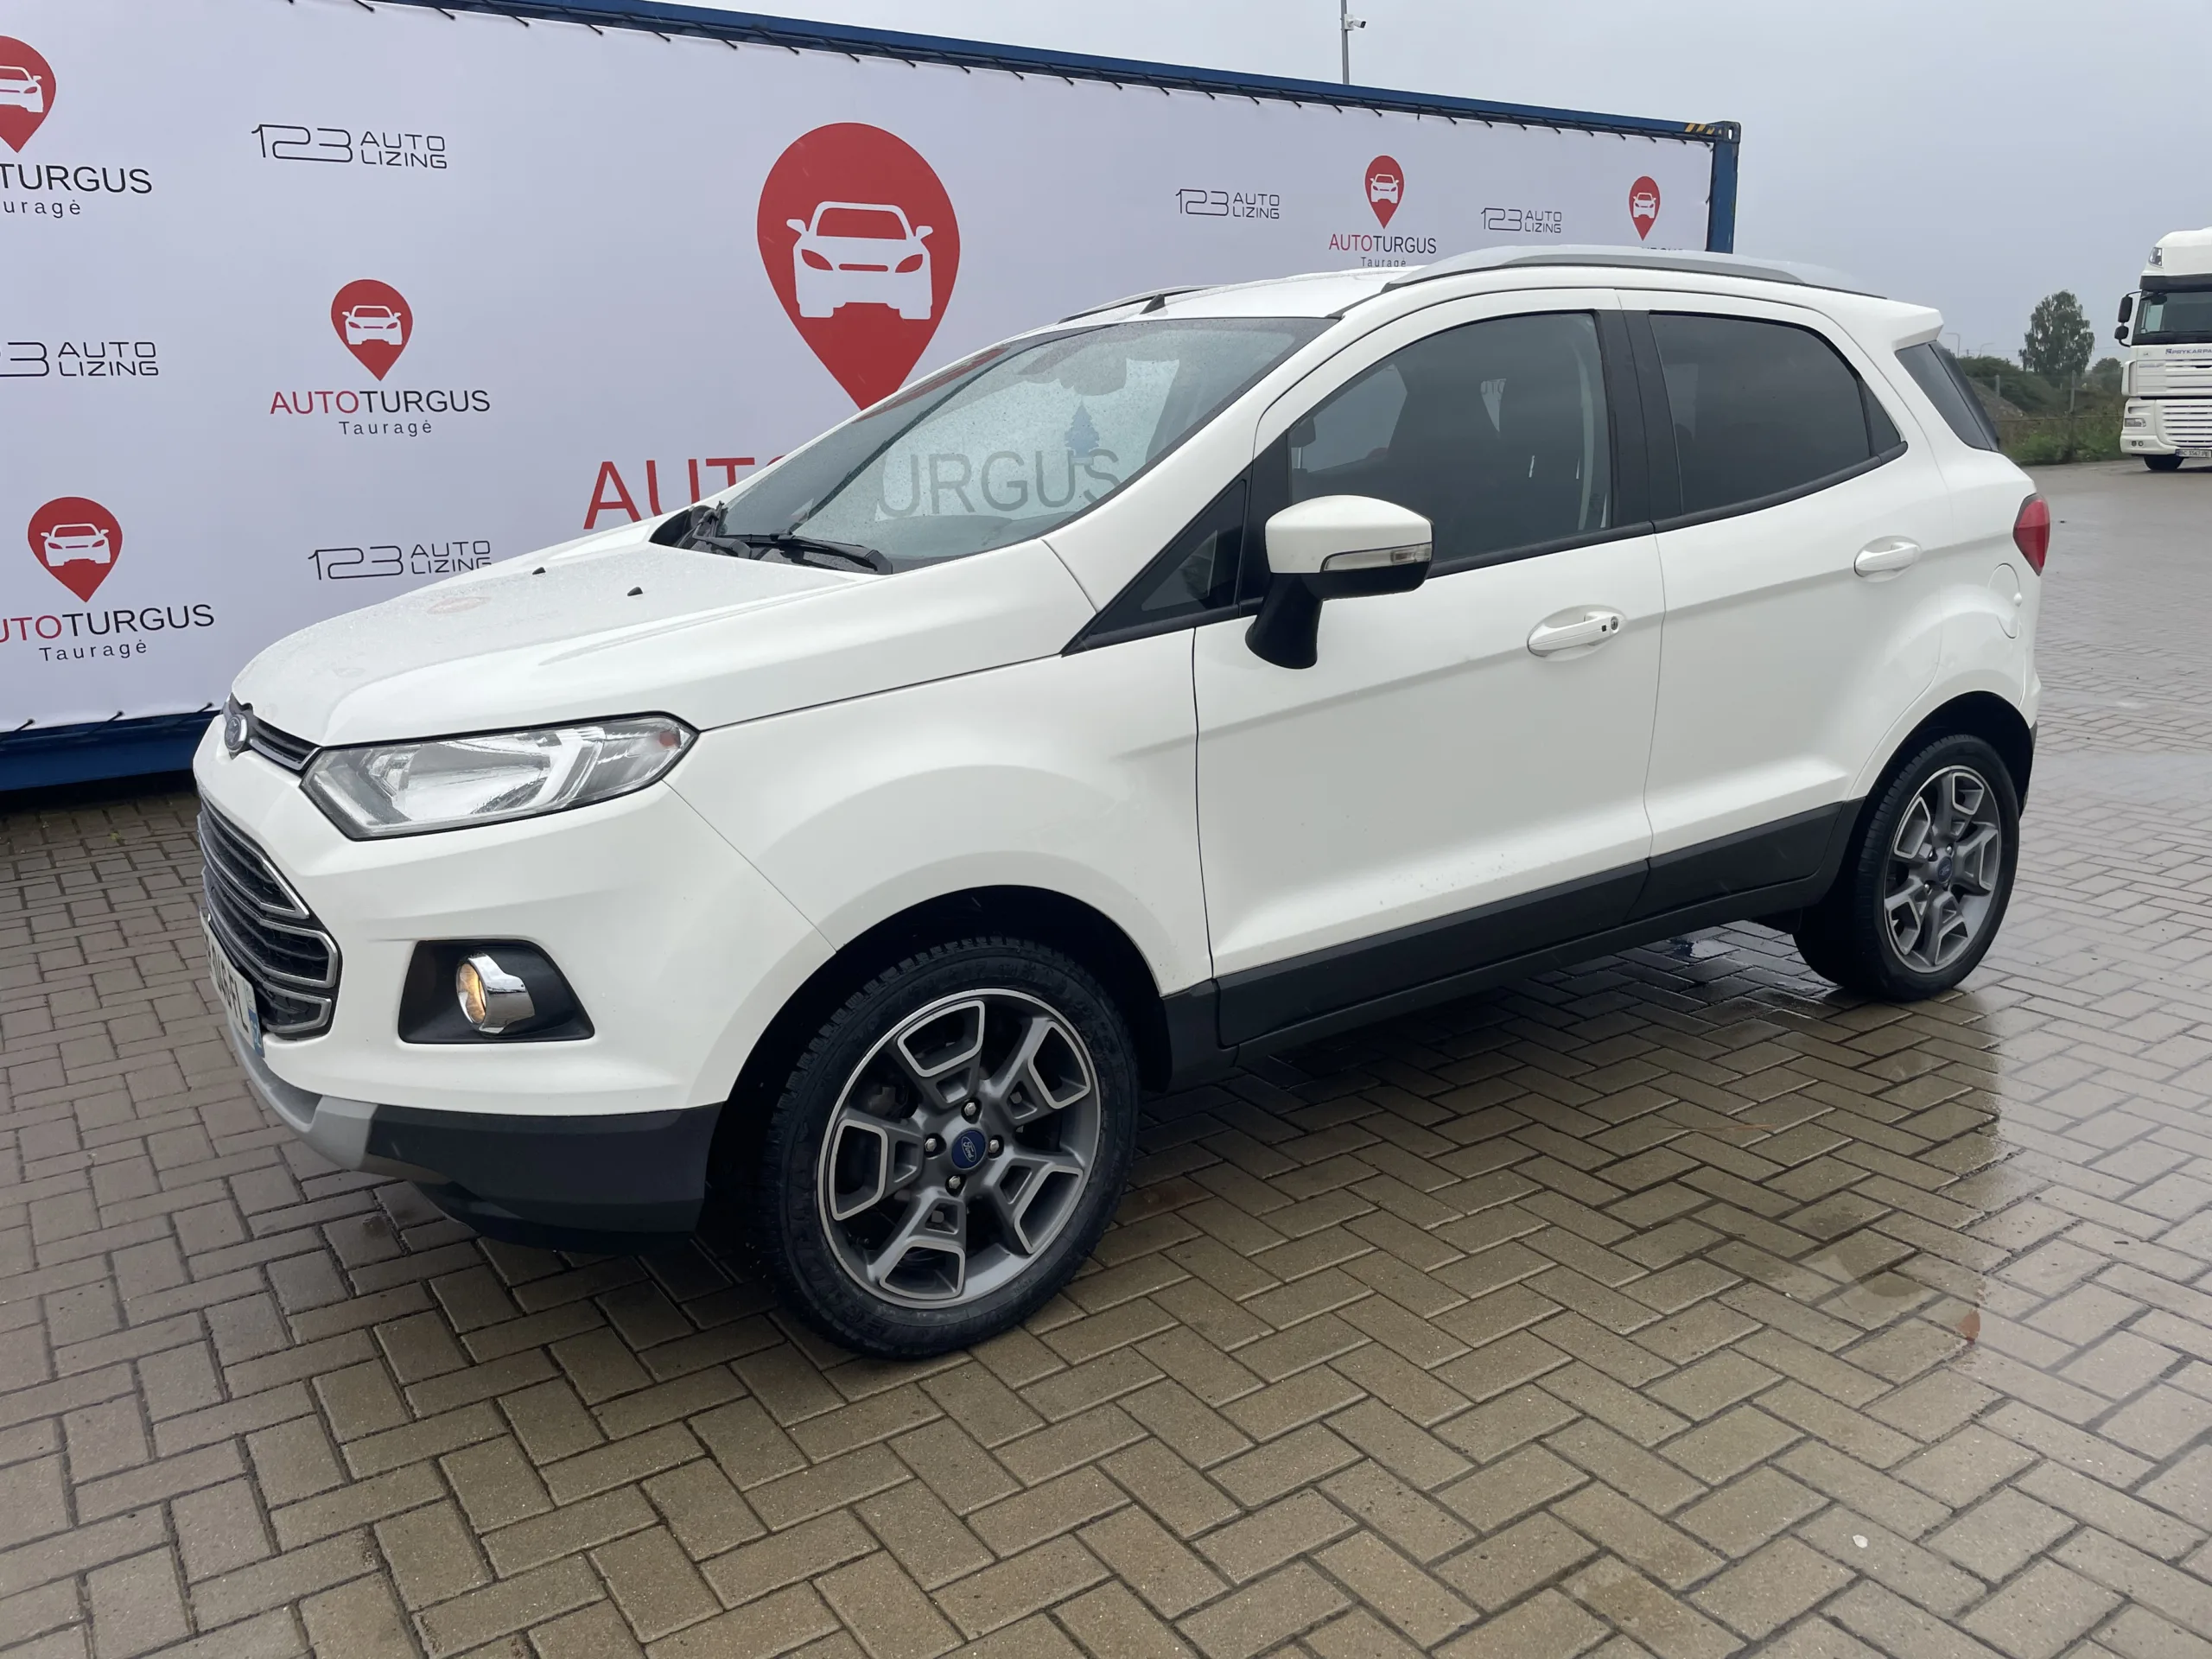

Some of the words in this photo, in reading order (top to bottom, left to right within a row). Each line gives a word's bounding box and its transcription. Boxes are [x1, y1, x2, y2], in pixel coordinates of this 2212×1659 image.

[251, 124, 353, 162] 123
[360, 131, 445, 152] AUTO
[361, 150, 447, 169] LIZING
[1175, 188, 1229, 216] 123
[1233, 193, 1280, 206] AUTO
[1233, 207, 1280, 219] LIZING
[1481, 207, 1522, 231] 123
[1525, 210, 1562, 222] AUTO
[1524, 222, 1561, 233] LIZING
[1329, 233, 1437, 254] AUTOTURGUS
[58, 342, 156, 358] AUTO
[59, 361, 158, 377] LIZING
[270, 390, 491, 415] AUTOTURGUS
[339, 420, 432, 437] Tauragė
[410, 541, 490, 558] AUTO
[308, 545, 404, 581] 123
[39, 639, 147, 662] Tauragė
